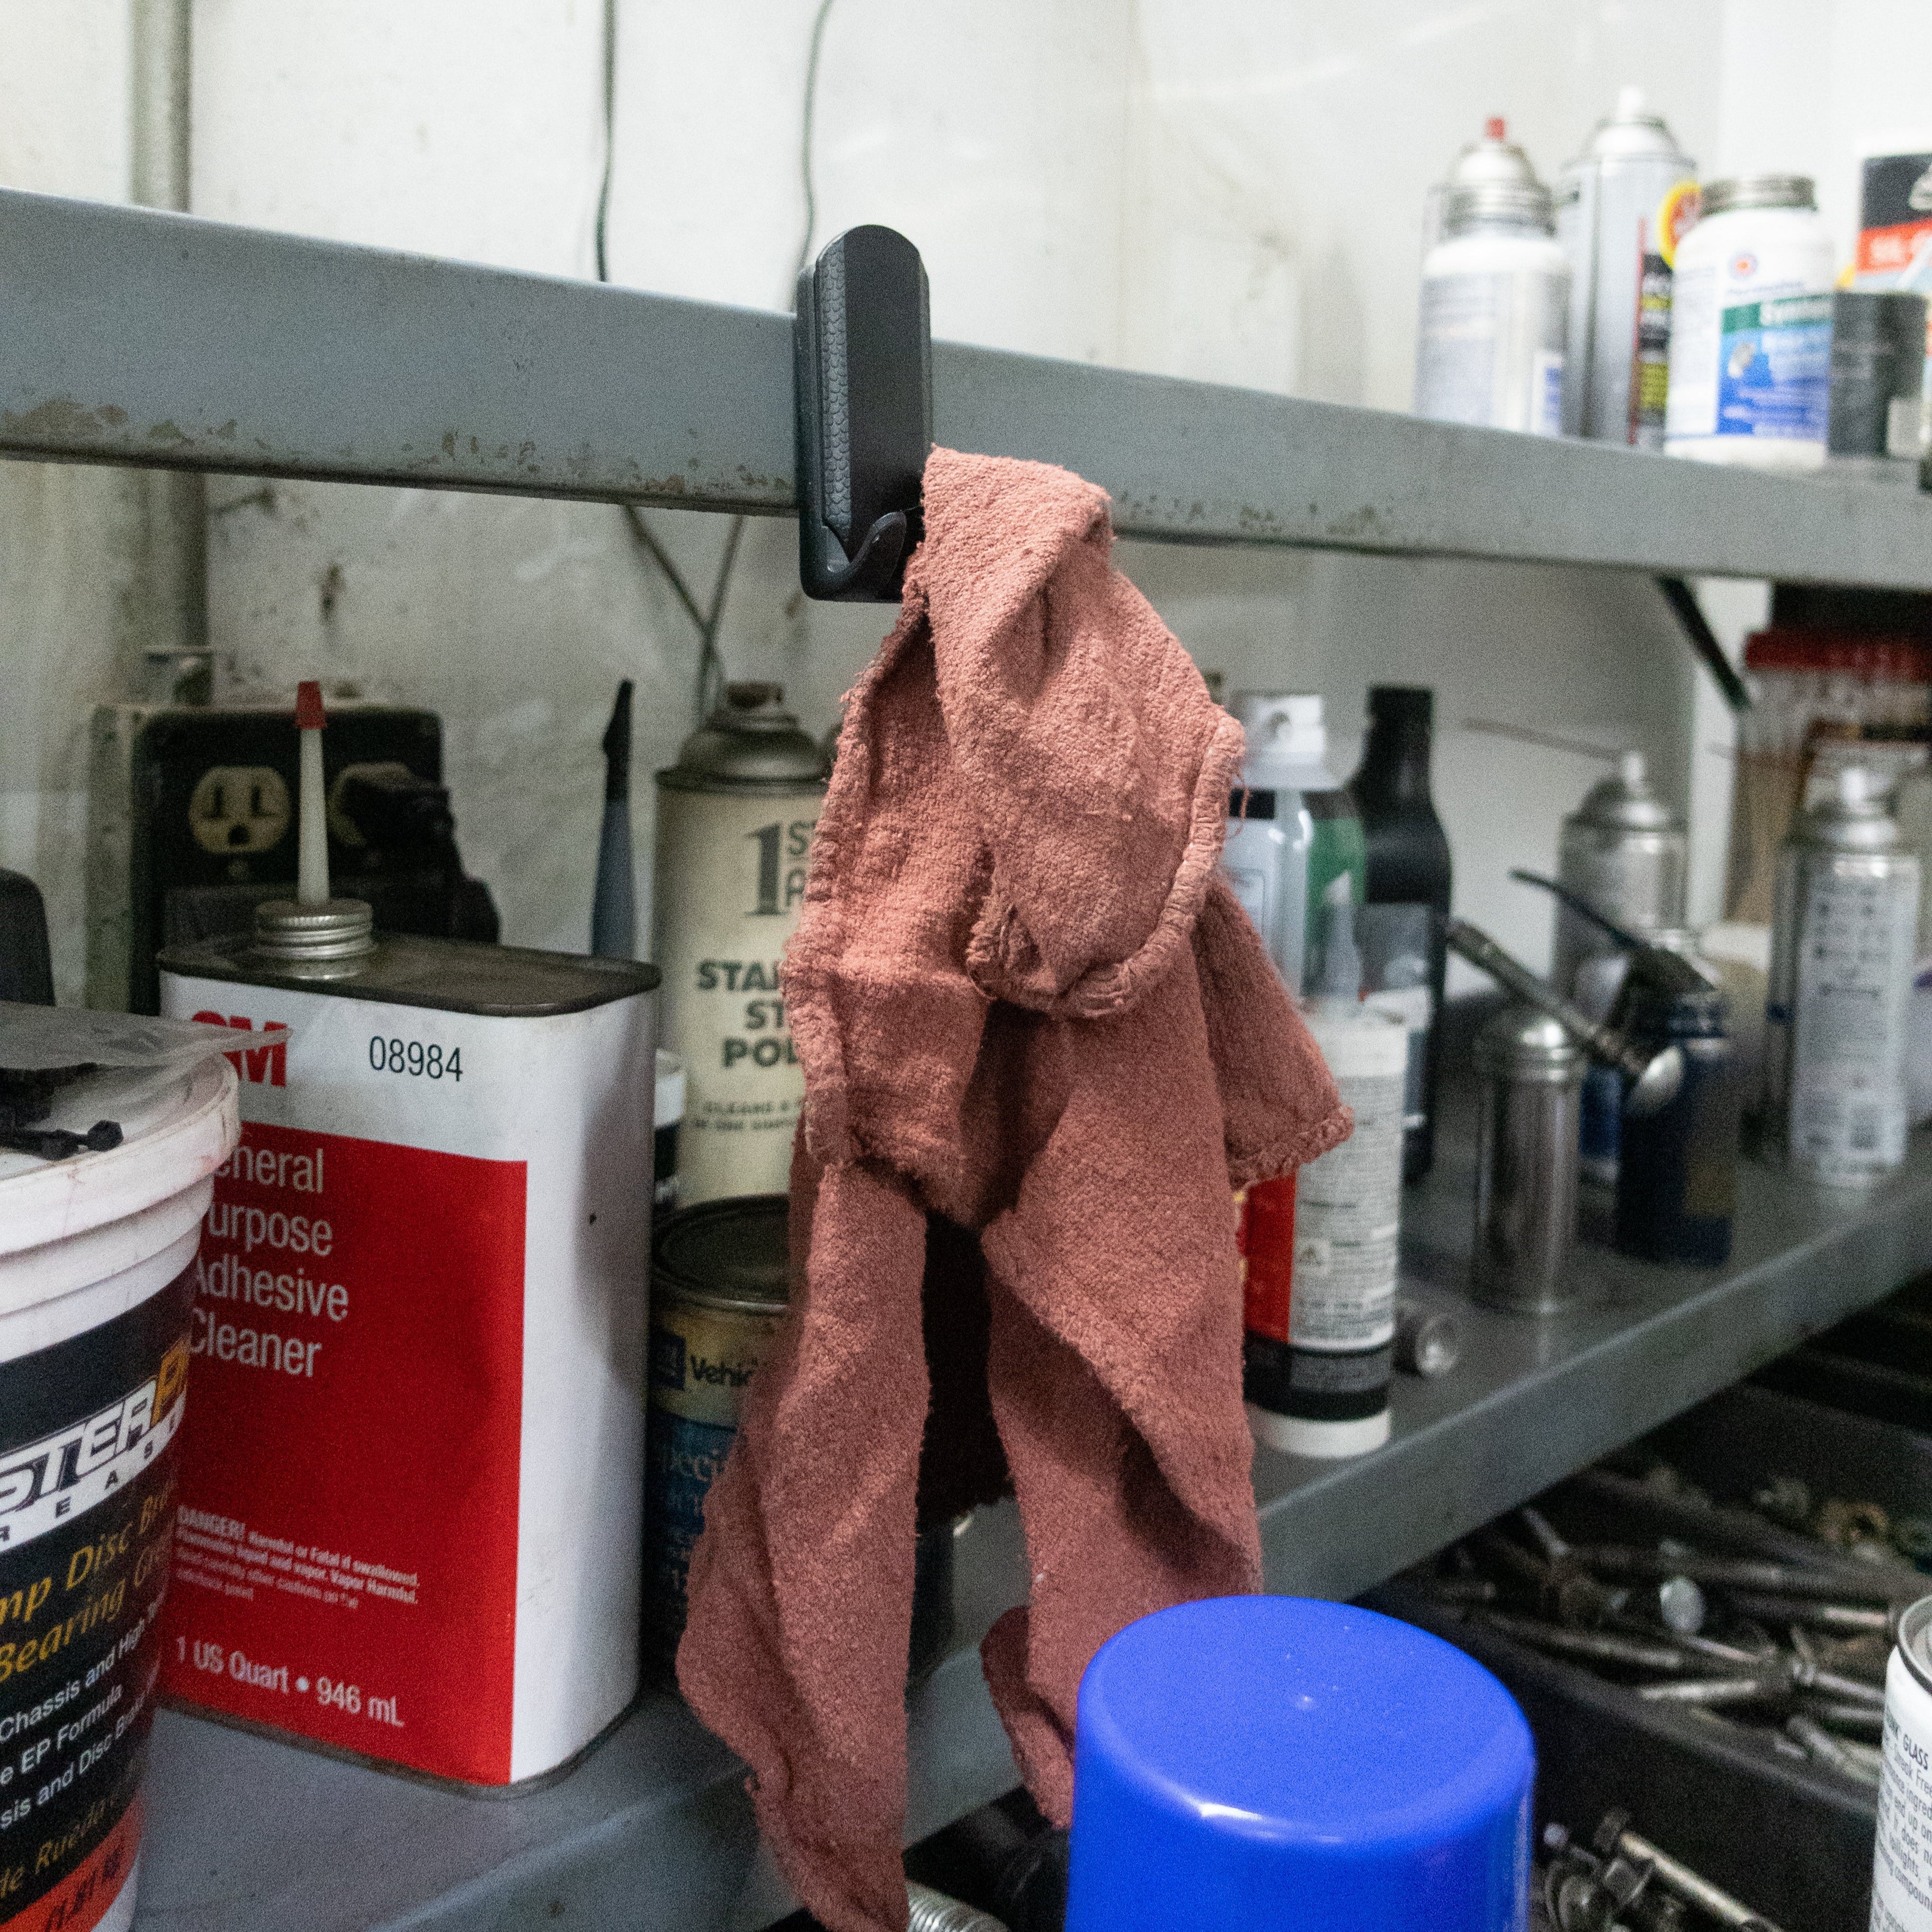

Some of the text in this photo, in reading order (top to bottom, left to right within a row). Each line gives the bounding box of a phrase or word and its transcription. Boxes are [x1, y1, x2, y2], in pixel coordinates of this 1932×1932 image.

[788, 820, 819, 856] S
[192, 1010, 287, 1087] M
[370, 1035, 462, 1082] 08984
[722, 1035, 799, 1068] POL
[191, 1308, 322, 1378] Cleaner
[66, 1522, 133, 1590] Disc
[0, 1679, 80, 1744] Chassis
[85, 1643, 115, 1688] and
[176, 1635, 404, 1728] 1 US Quart 946 mL
[21, 1738, 51, 1774] EP
[57, 1683, 123, 1750] Formula
[1903, 1733, 1929, 1770] GLASS
[37, 1762, 75, 1806] and
[79, 1733, 113, 1775] Disc
